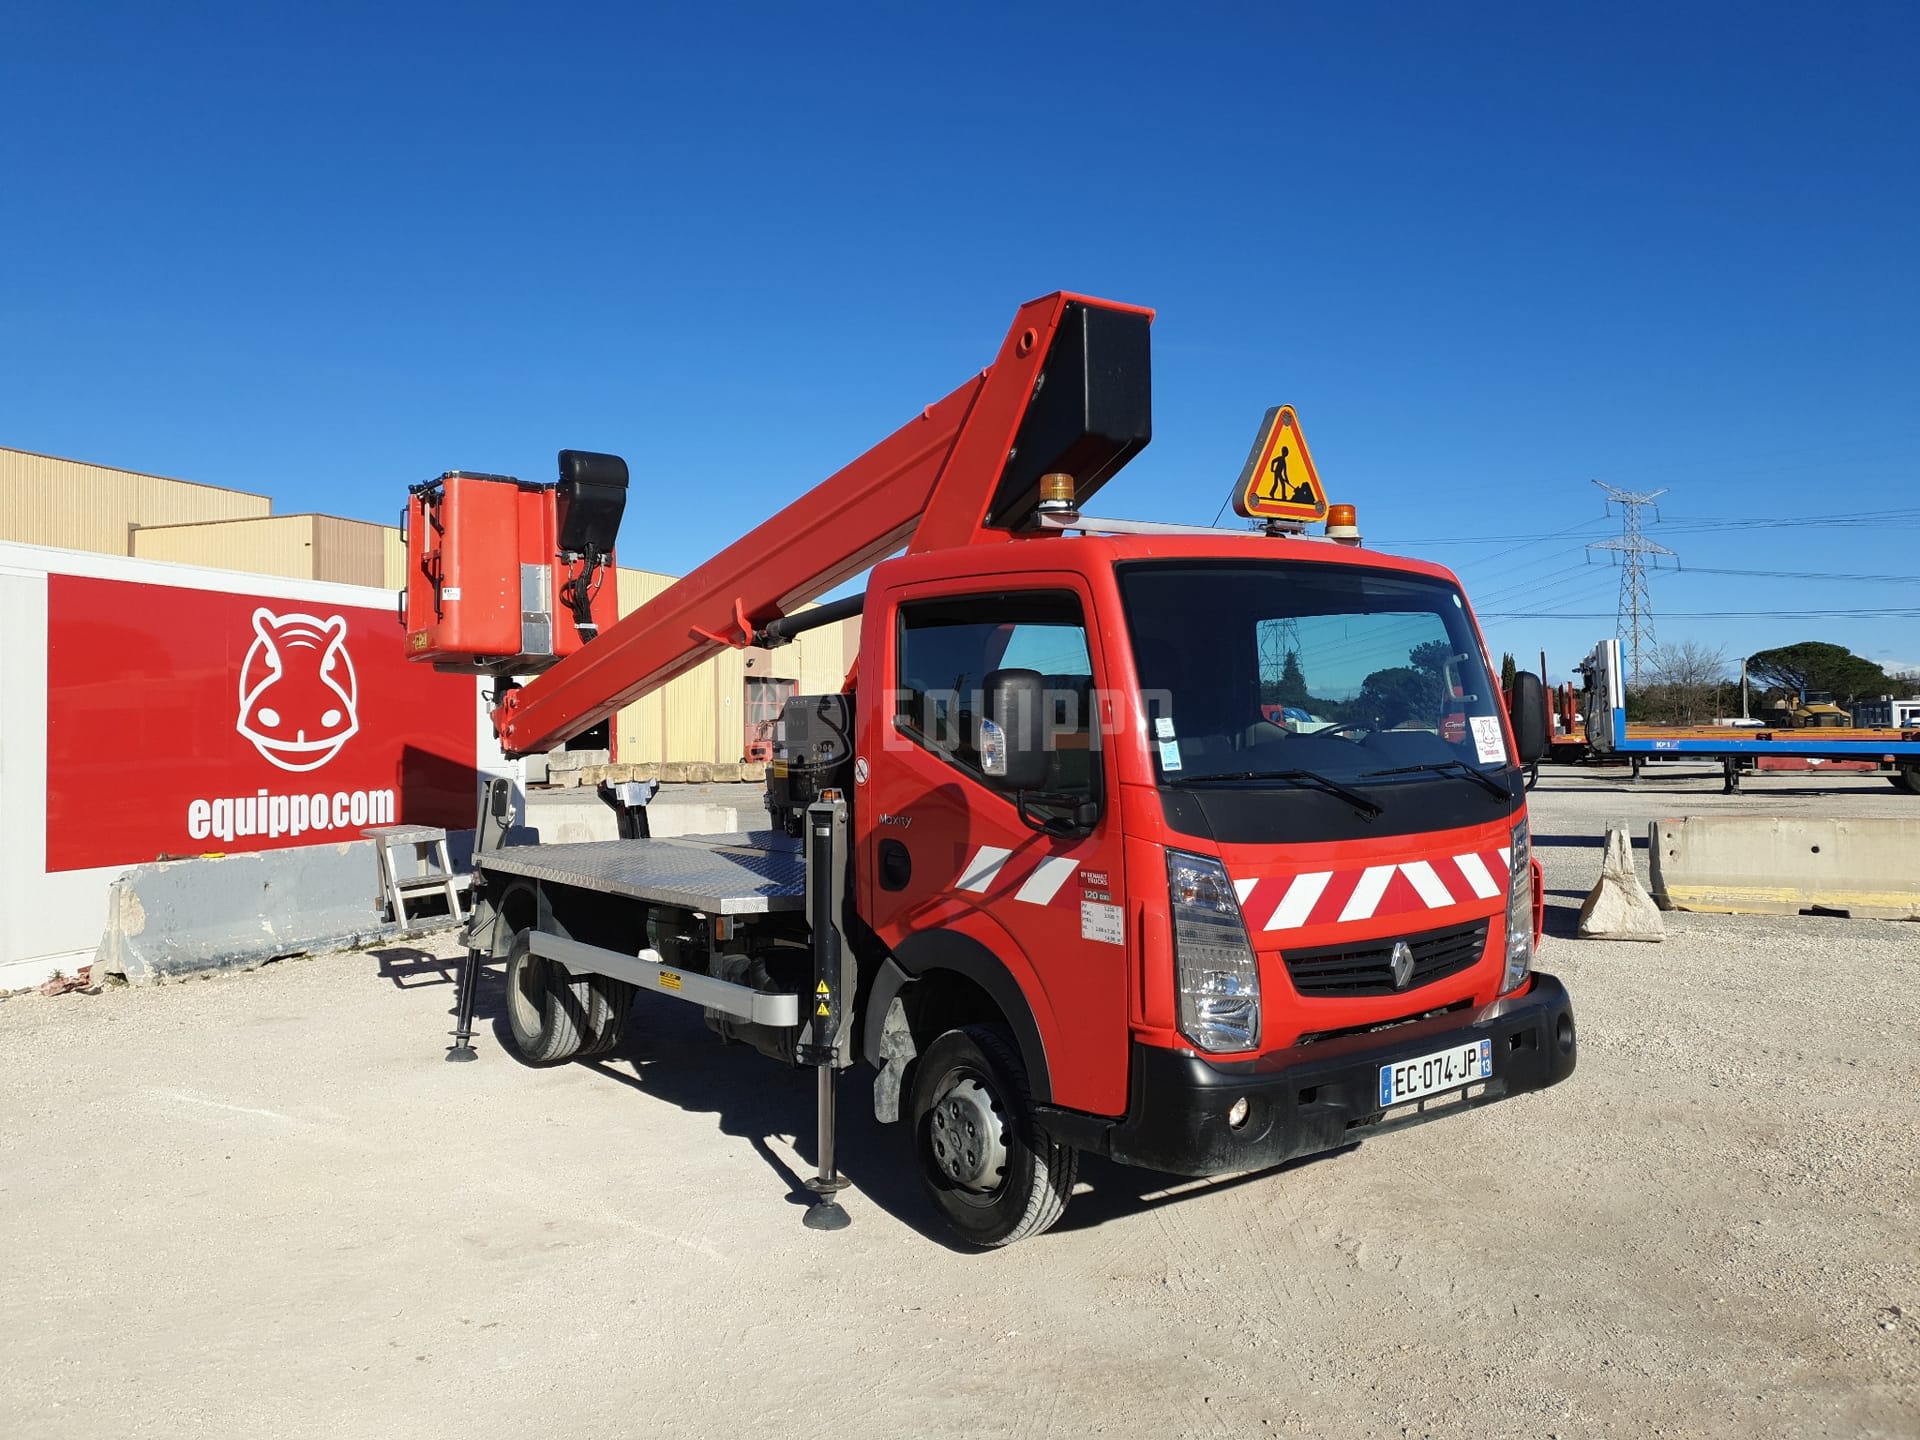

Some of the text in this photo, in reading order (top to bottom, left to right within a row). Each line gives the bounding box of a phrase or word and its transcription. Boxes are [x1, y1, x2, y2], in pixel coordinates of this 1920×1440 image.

[187, 788, 395, 842] equippo.com
[1087, 872, 1108, 880] RENAULT
[1087, 877, 1108, 886] TRUCKS
[1085, 890, 1098, 900] 120
[1481, 1060, 1490, 1073] 13
